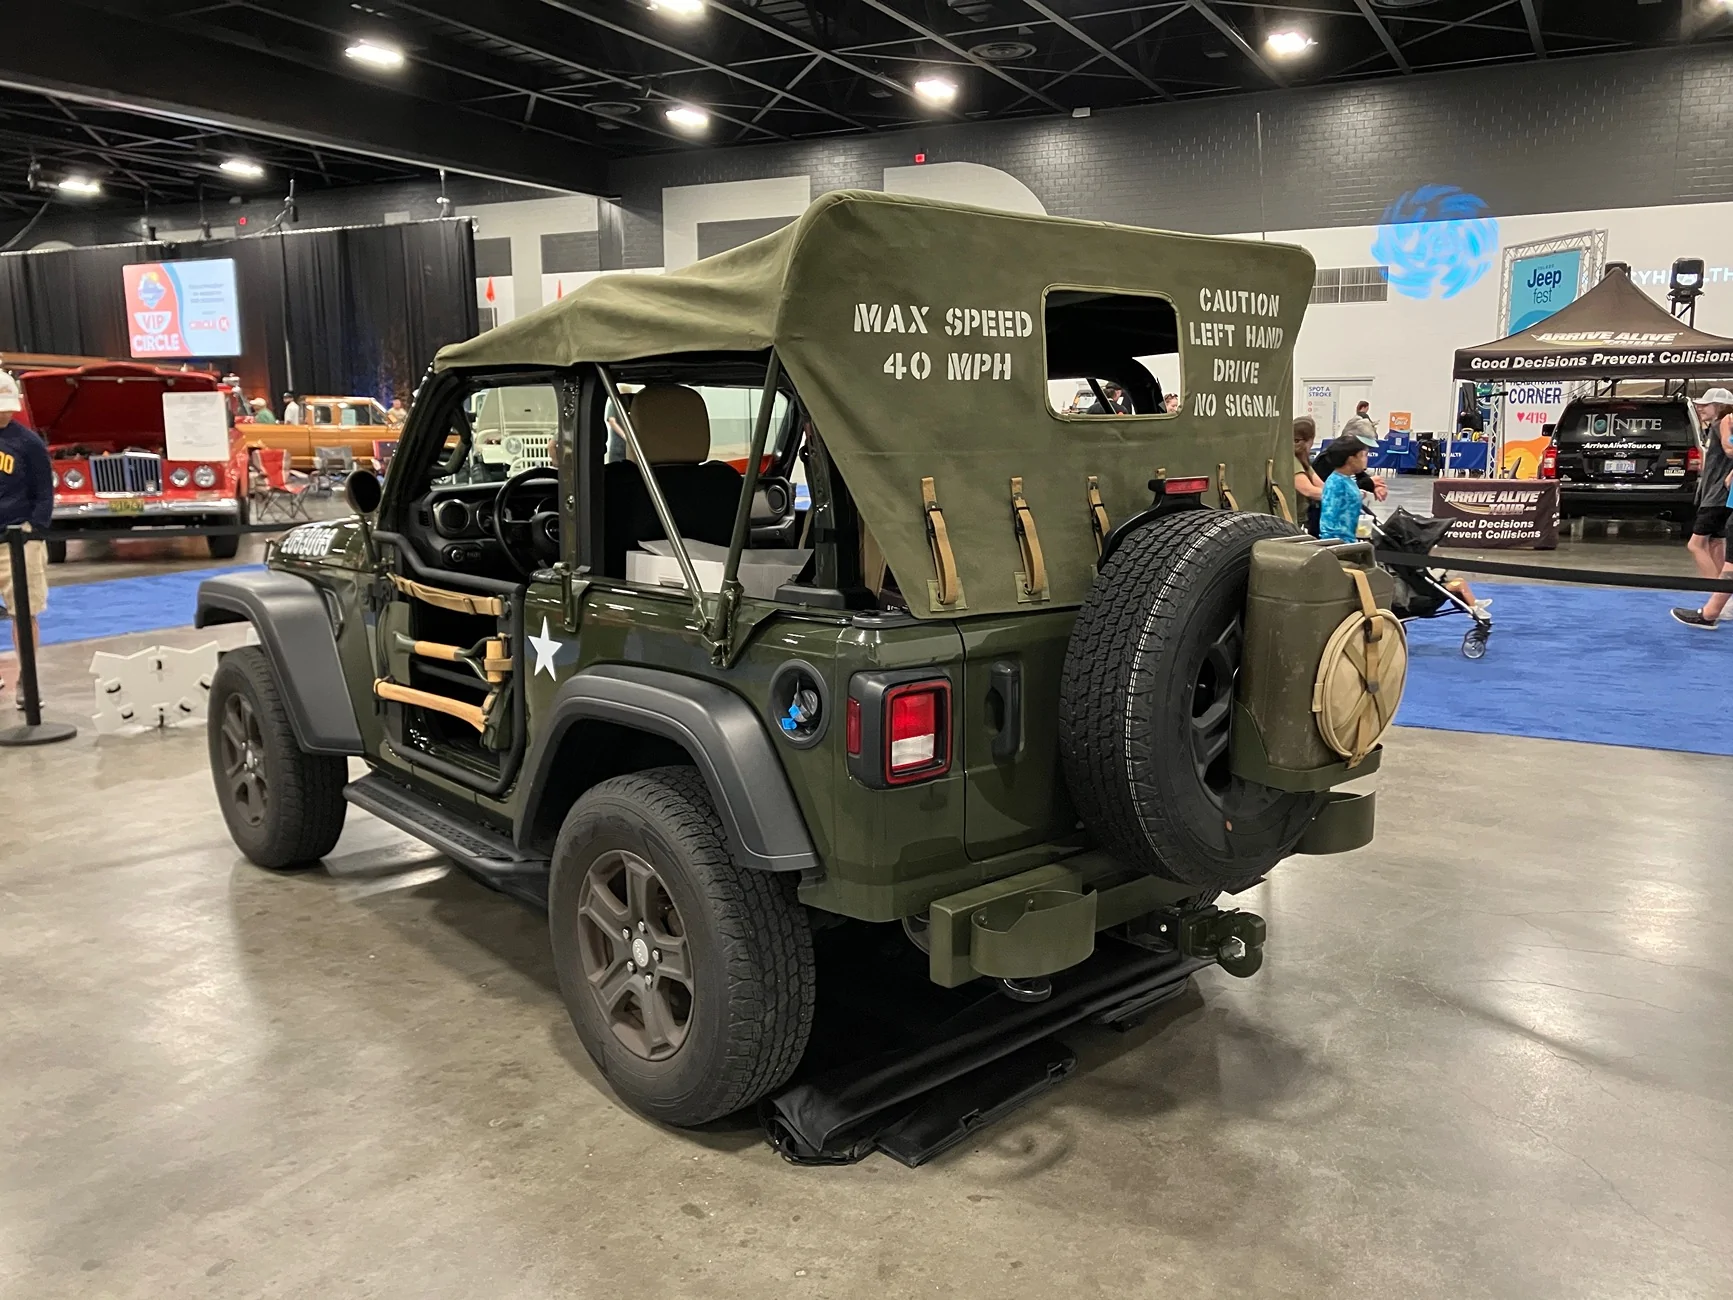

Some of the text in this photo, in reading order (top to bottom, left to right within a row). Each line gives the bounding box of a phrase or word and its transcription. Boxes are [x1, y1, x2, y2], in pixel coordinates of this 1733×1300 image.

[1527, 268, 1562, 288] Jeep
[1199, 287, 1280, 318] CAUTION
[1533, 287, 1553, 304] fest
[142, 314, 164, 329] VIP
[853, 303, 1033, 338] MAX SPEED
[132, 333, 180, 352] CIRCLE
[1189, 321, 1284, 349] LEFT HAND
[1537, 331, 1678, 342] ARRIVE ALIVE
[883, 351, 1012, 381] 40 MPH
[1470, 357, 1510, 369] Good
[1512, 355, 1588, 369] Decisions
[1590, 352, 1656, 366] Prevent
[1213, 358, 1260, 384] DRIVE
[1509, 387, 1562, 405] CORNER
[1193, 393, 1280, 418] NO SIGNAL
[1525, 411, 1547, 424] 419
[1583, 412, 1662, 437] UNITE
[1444, 490, 1540, 503] ARRIVE ALIVE
[1478, 519, 1534, 529] Decisions
[1485, 529, 1541, 539] Collisions
